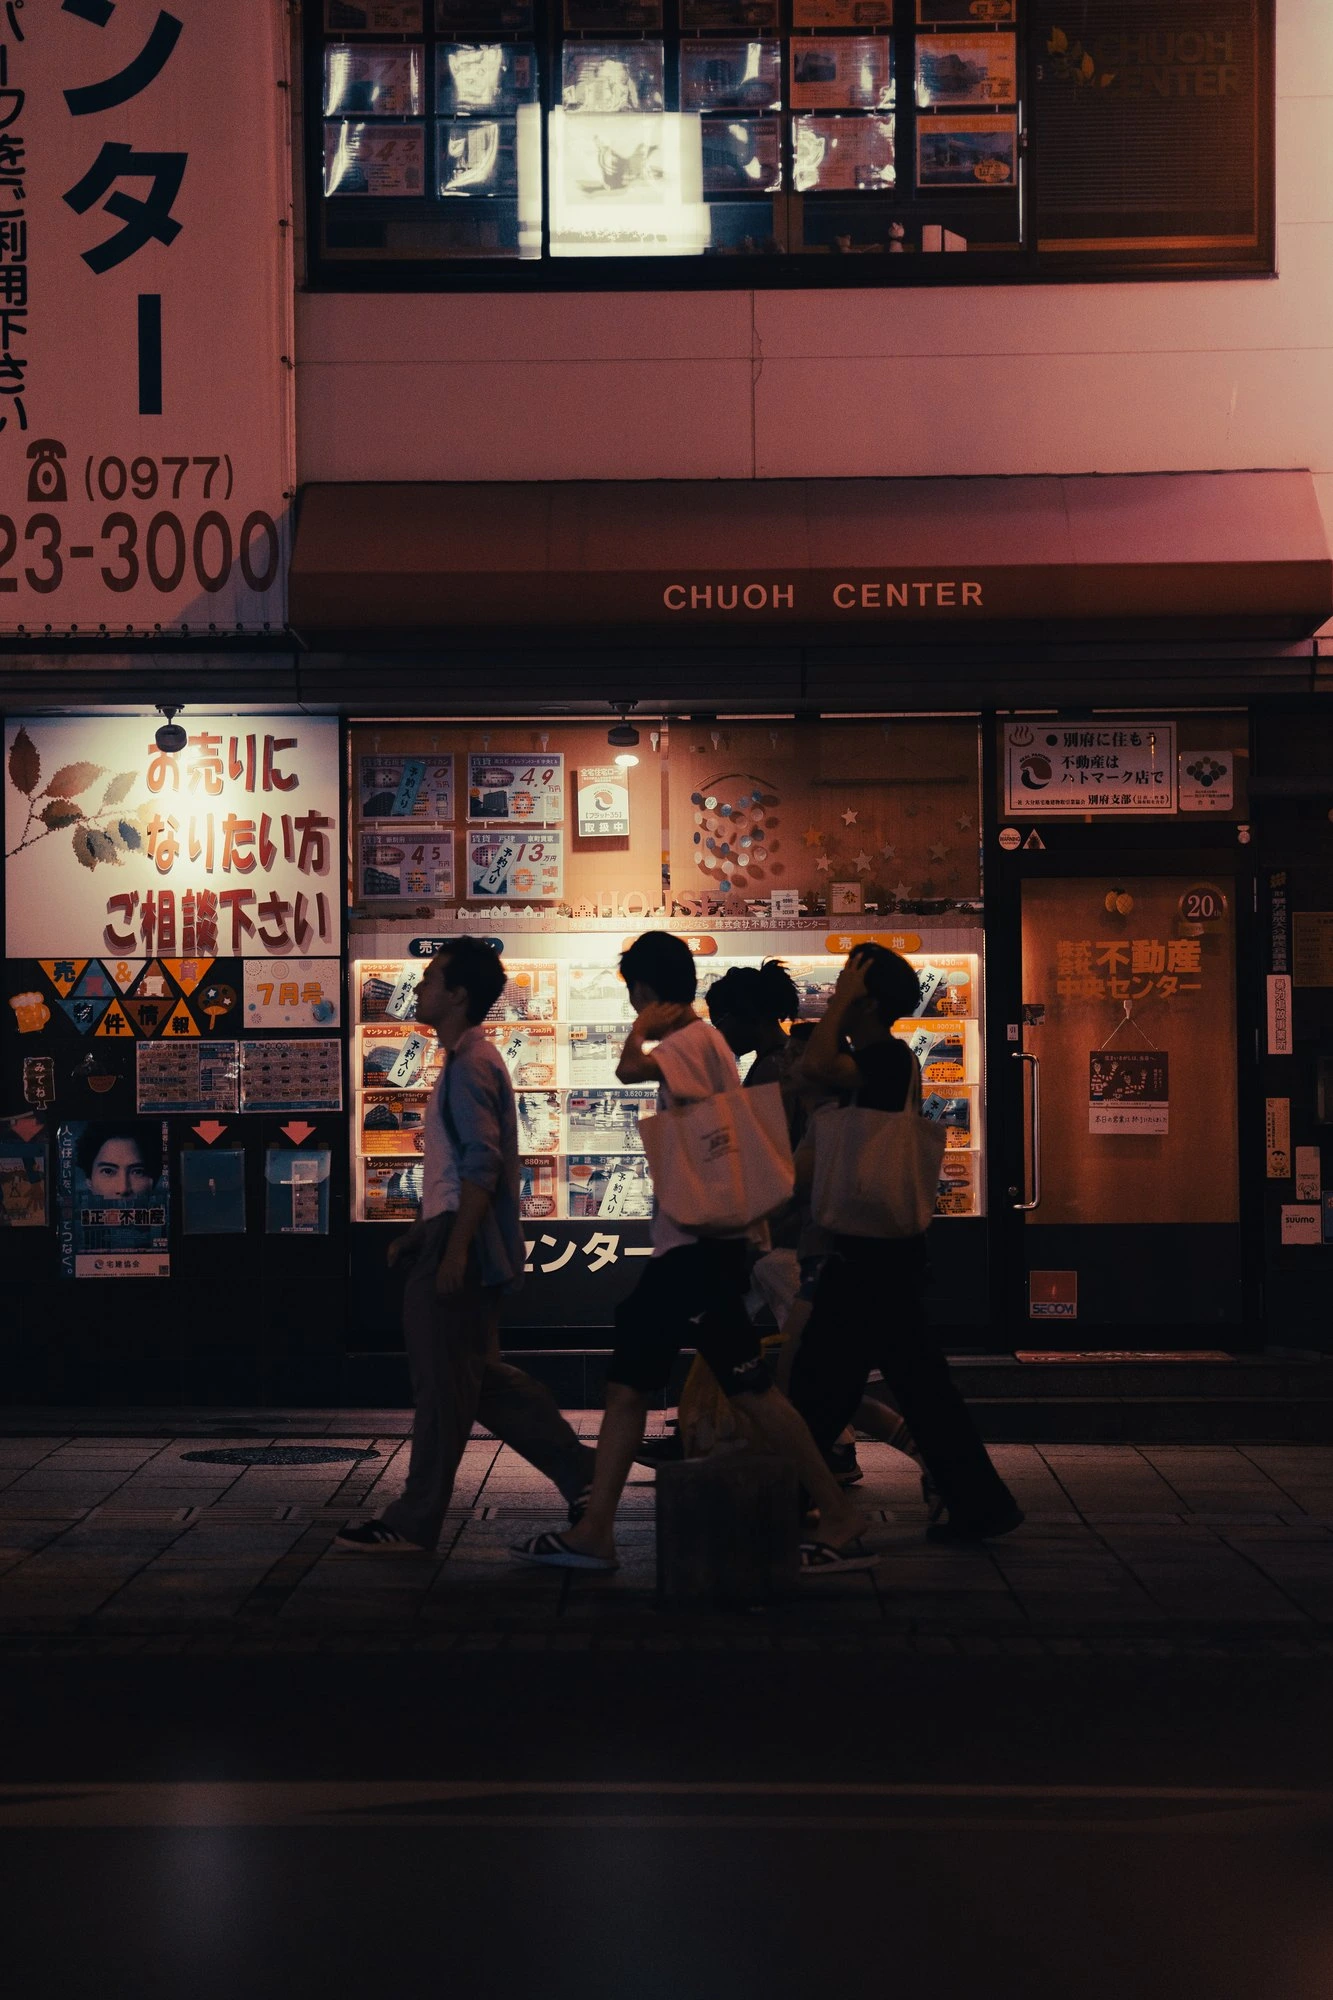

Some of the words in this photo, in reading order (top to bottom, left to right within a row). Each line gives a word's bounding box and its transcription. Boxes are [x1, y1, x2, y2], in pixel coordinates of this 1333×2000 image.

[62, 0, 189, 415] ンター
[85, 455, 234, 501] (0977)
[663, 583, 794, 610] CHUOH
[832, 582, 984, 609] CENTER
[1063, 732, 1157, 747] 別府に住もう
[147, 731, 298, 794] お売りに
[1062, 755, 1119, 769] 不動産は
[1062, 770, 1164, 785] ハトマーク店で
[400, 766, 419, 809] 予約入り
[520, 768, 554, 788] 4.9
[1088, 794, 1132, 806] 別府支部
[147, 810, 332, 872] なりたい方
[584, 821, 624, 832] 取扱中
[488, 847, 513, 884] 予約入り
[105, 888, 330, 956] ご相談下さい
[715, 919, 827, 930] 株式会社不動産中央センター
[1095, 939, 1201, 974] 不動産
[257, 982, 325, 1006] 7月号
[394, 972, 417, 1012] 予約入り
[1056, 975, 1201, 1000] 中央センター
[397, 1039, 420, 1077] 予約入り
[34, 1062, 46, 1099] みてね
[606, 1172, 626, 1214] 予約入り
[1286, 1216, 1315, 1224] suumo
[106, 1259, 140, 1269] 宅建協会
[523, 1232, 656, 1273] ンター
[1033, 1303, 1074, 1315] SECOM
